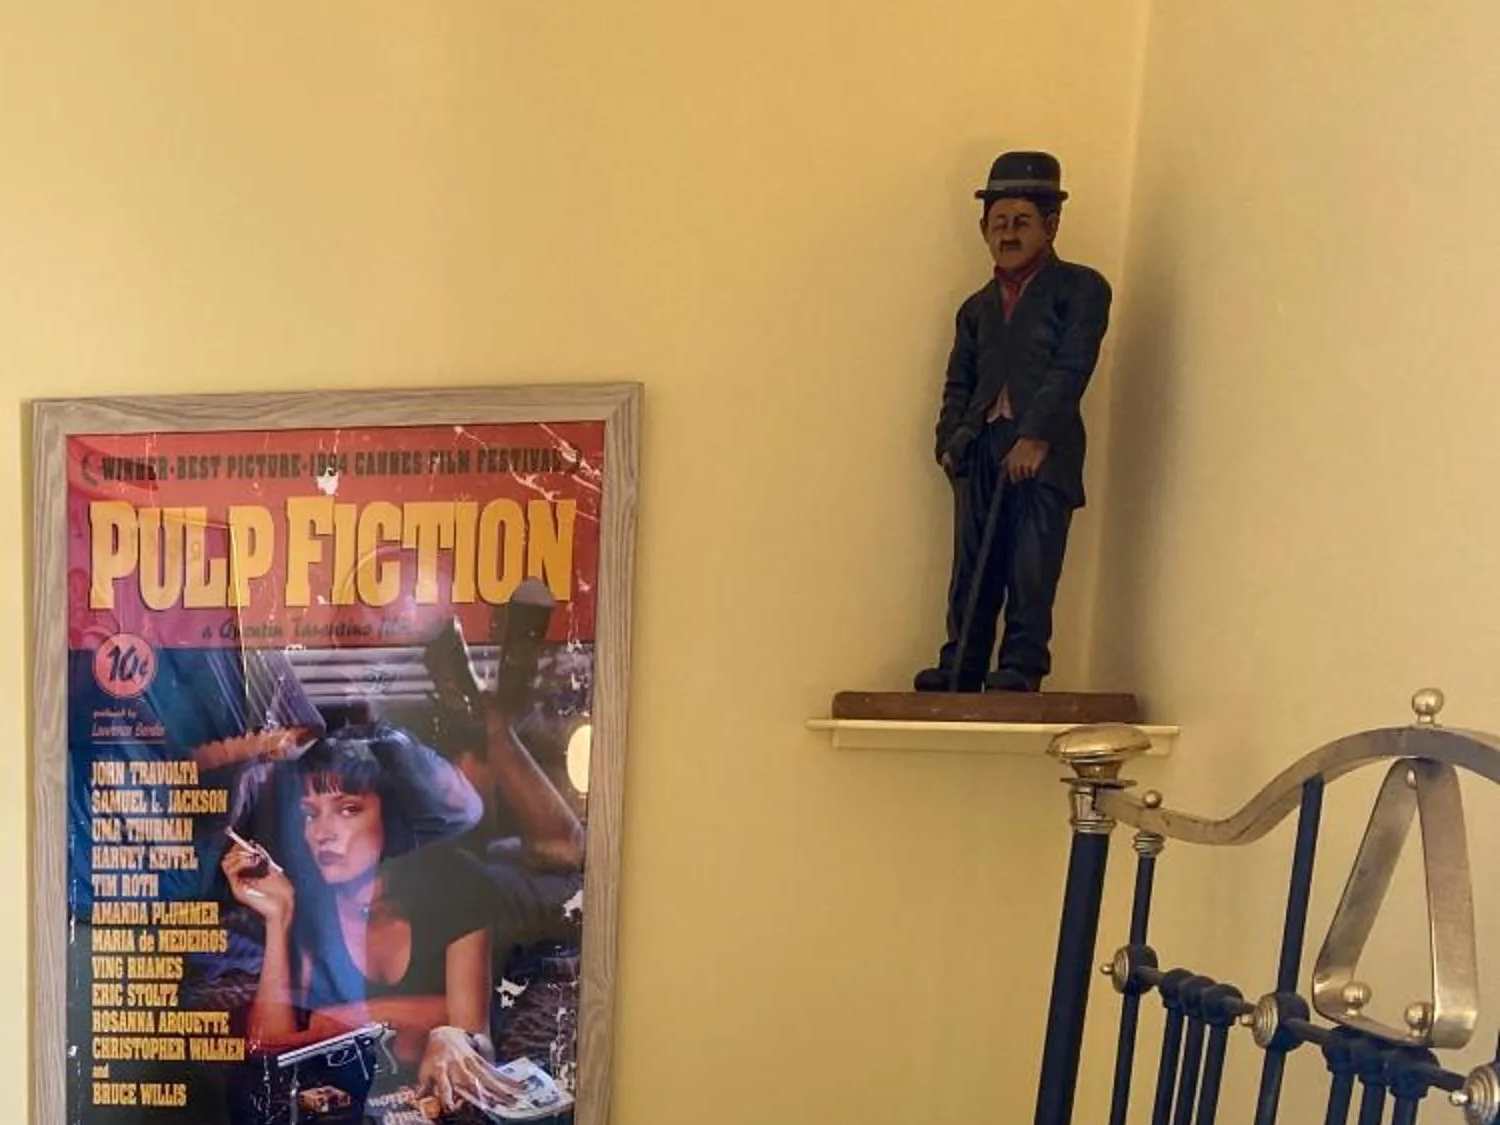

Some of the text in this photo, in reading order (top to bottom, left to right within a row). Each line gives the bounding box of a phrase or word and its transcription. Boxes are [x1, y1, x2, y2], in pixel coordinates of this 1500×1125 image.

[101, 456, 168, 481] WINNER
[177, 455, 220, 480] BEST
[227, 453, 301, 479] PICTURE
[355, 451, 422, 476] CANNES
[89, 496, 576, 611] PULP FICTION
[91, 761, 198, 785] JOHN TRAVOLTA
[91, 790, 147, 813] SAMUEL
[168, 790, 228, 813] JACKSON
[91, 817, 193, 842] UMA THURMAN
[91, 845, 198, 870] HARVEY KEITEL
[91, 873, 159, 897] TIM ROTH
[91, 901, 219, 925] AMANDA PLUMMER
[91, 929, 228, 953] MARIA de MEDEIROS
[91, 956, 184, 979] VING RHAMES
[91, 983, 179, 1006] ERIC STOLTZ
[91, 1010, 230, 1035] ROSANNA ARQUETTE
[91, 1037, 245, 1061] CHRISTOPHER WALKEN
[91, 1083, 187, 1106] BRUCE WILLIS
